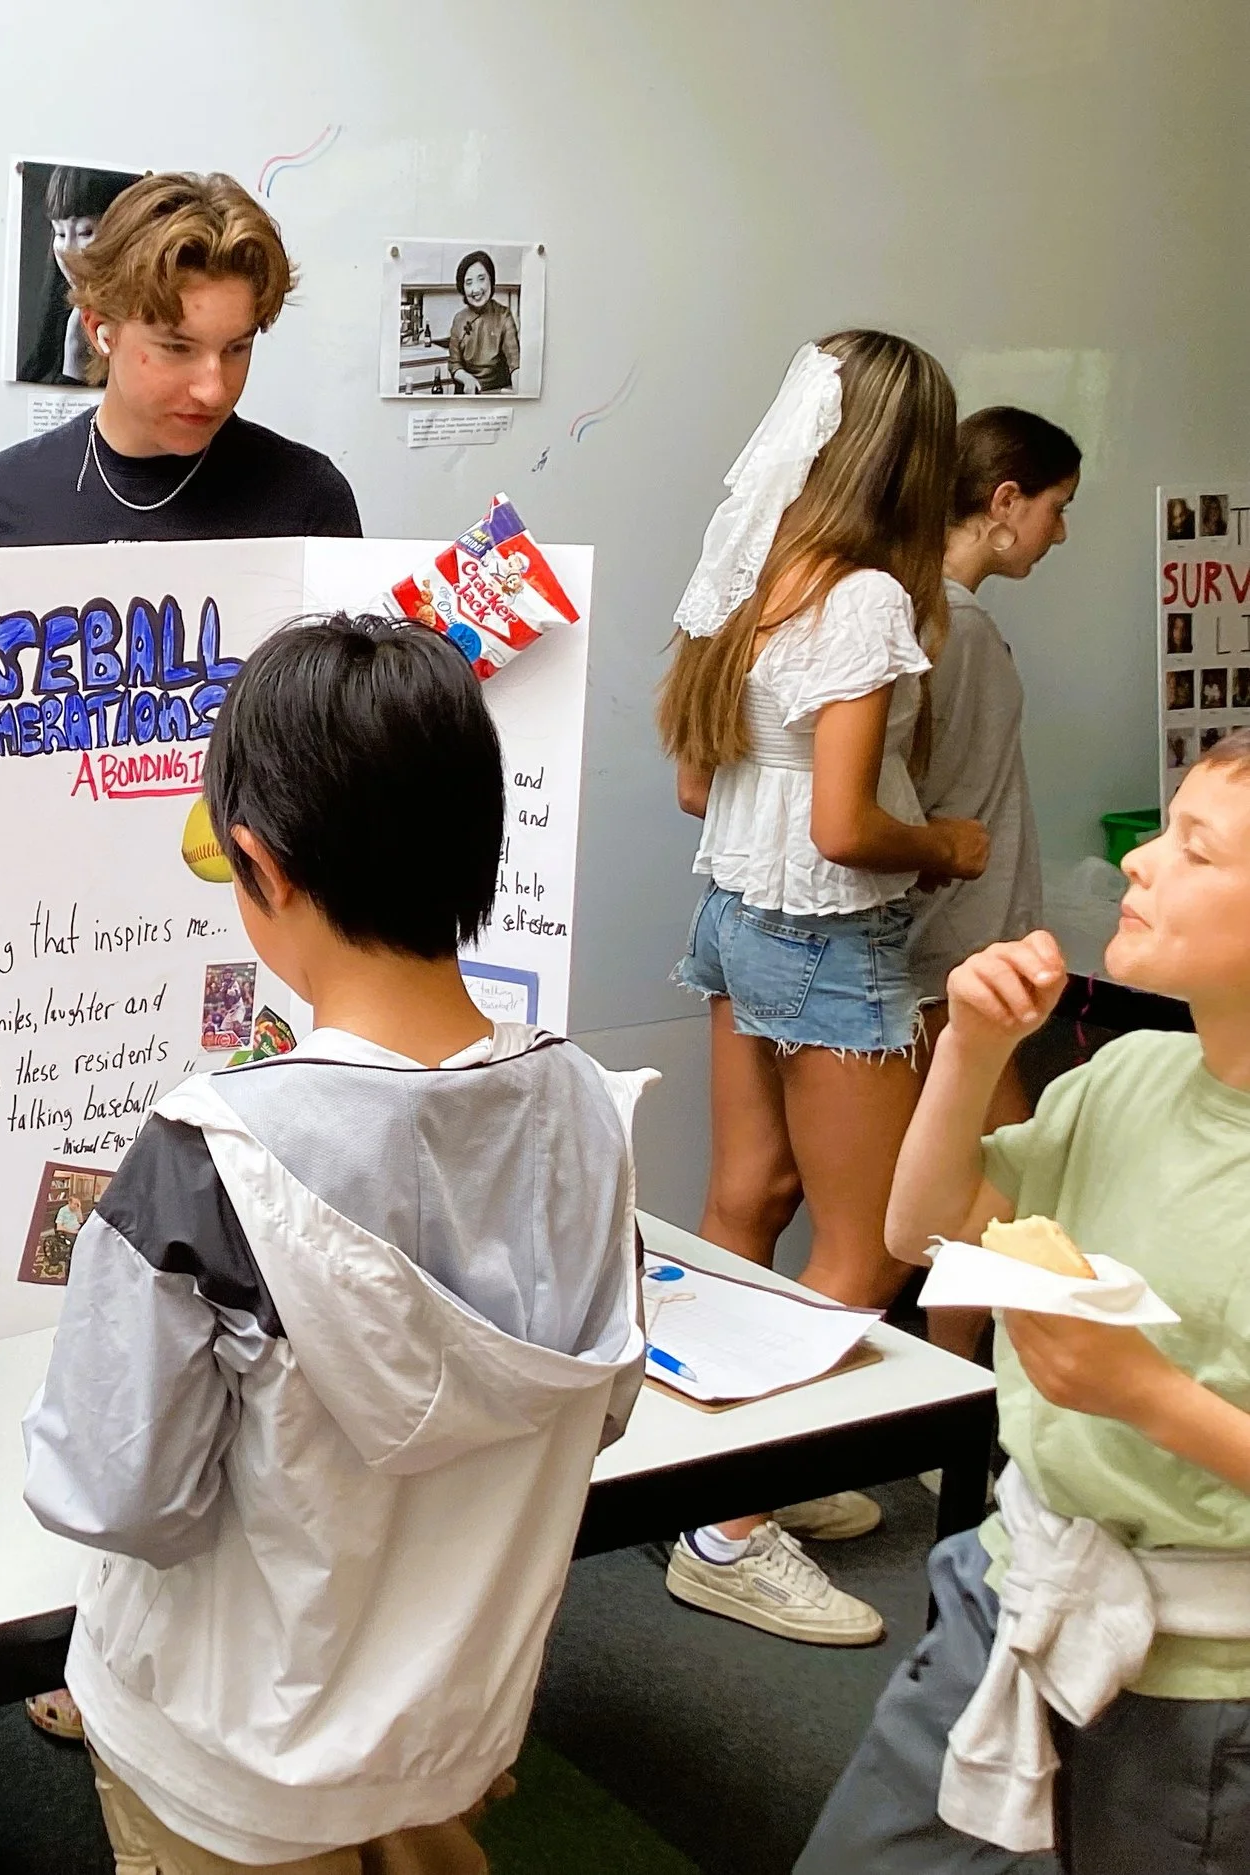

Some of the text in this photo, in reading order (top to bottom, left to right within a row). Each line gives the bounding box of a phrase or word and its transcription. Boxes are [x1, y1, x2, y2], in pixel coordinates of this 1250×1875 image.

[453, 582, 491, 623] Jack
[461, 561, 519, 623] Cracker
[70, 752, 98, 801] A
[97, 748, 188, 793] BONDING
[514, 766, 544, 789] and
[519, 803, 549, 827] and
[515, 870, 545, 902] help
[30, 900, 80, 958] that
[94, 915, 173, 952] inspires
[124, 983, 167, 1015] and
[16, 1050, 59, 1085] these
[75, 1034, 168, 1074] residents
[7, 1094, 73, 1132] talking
